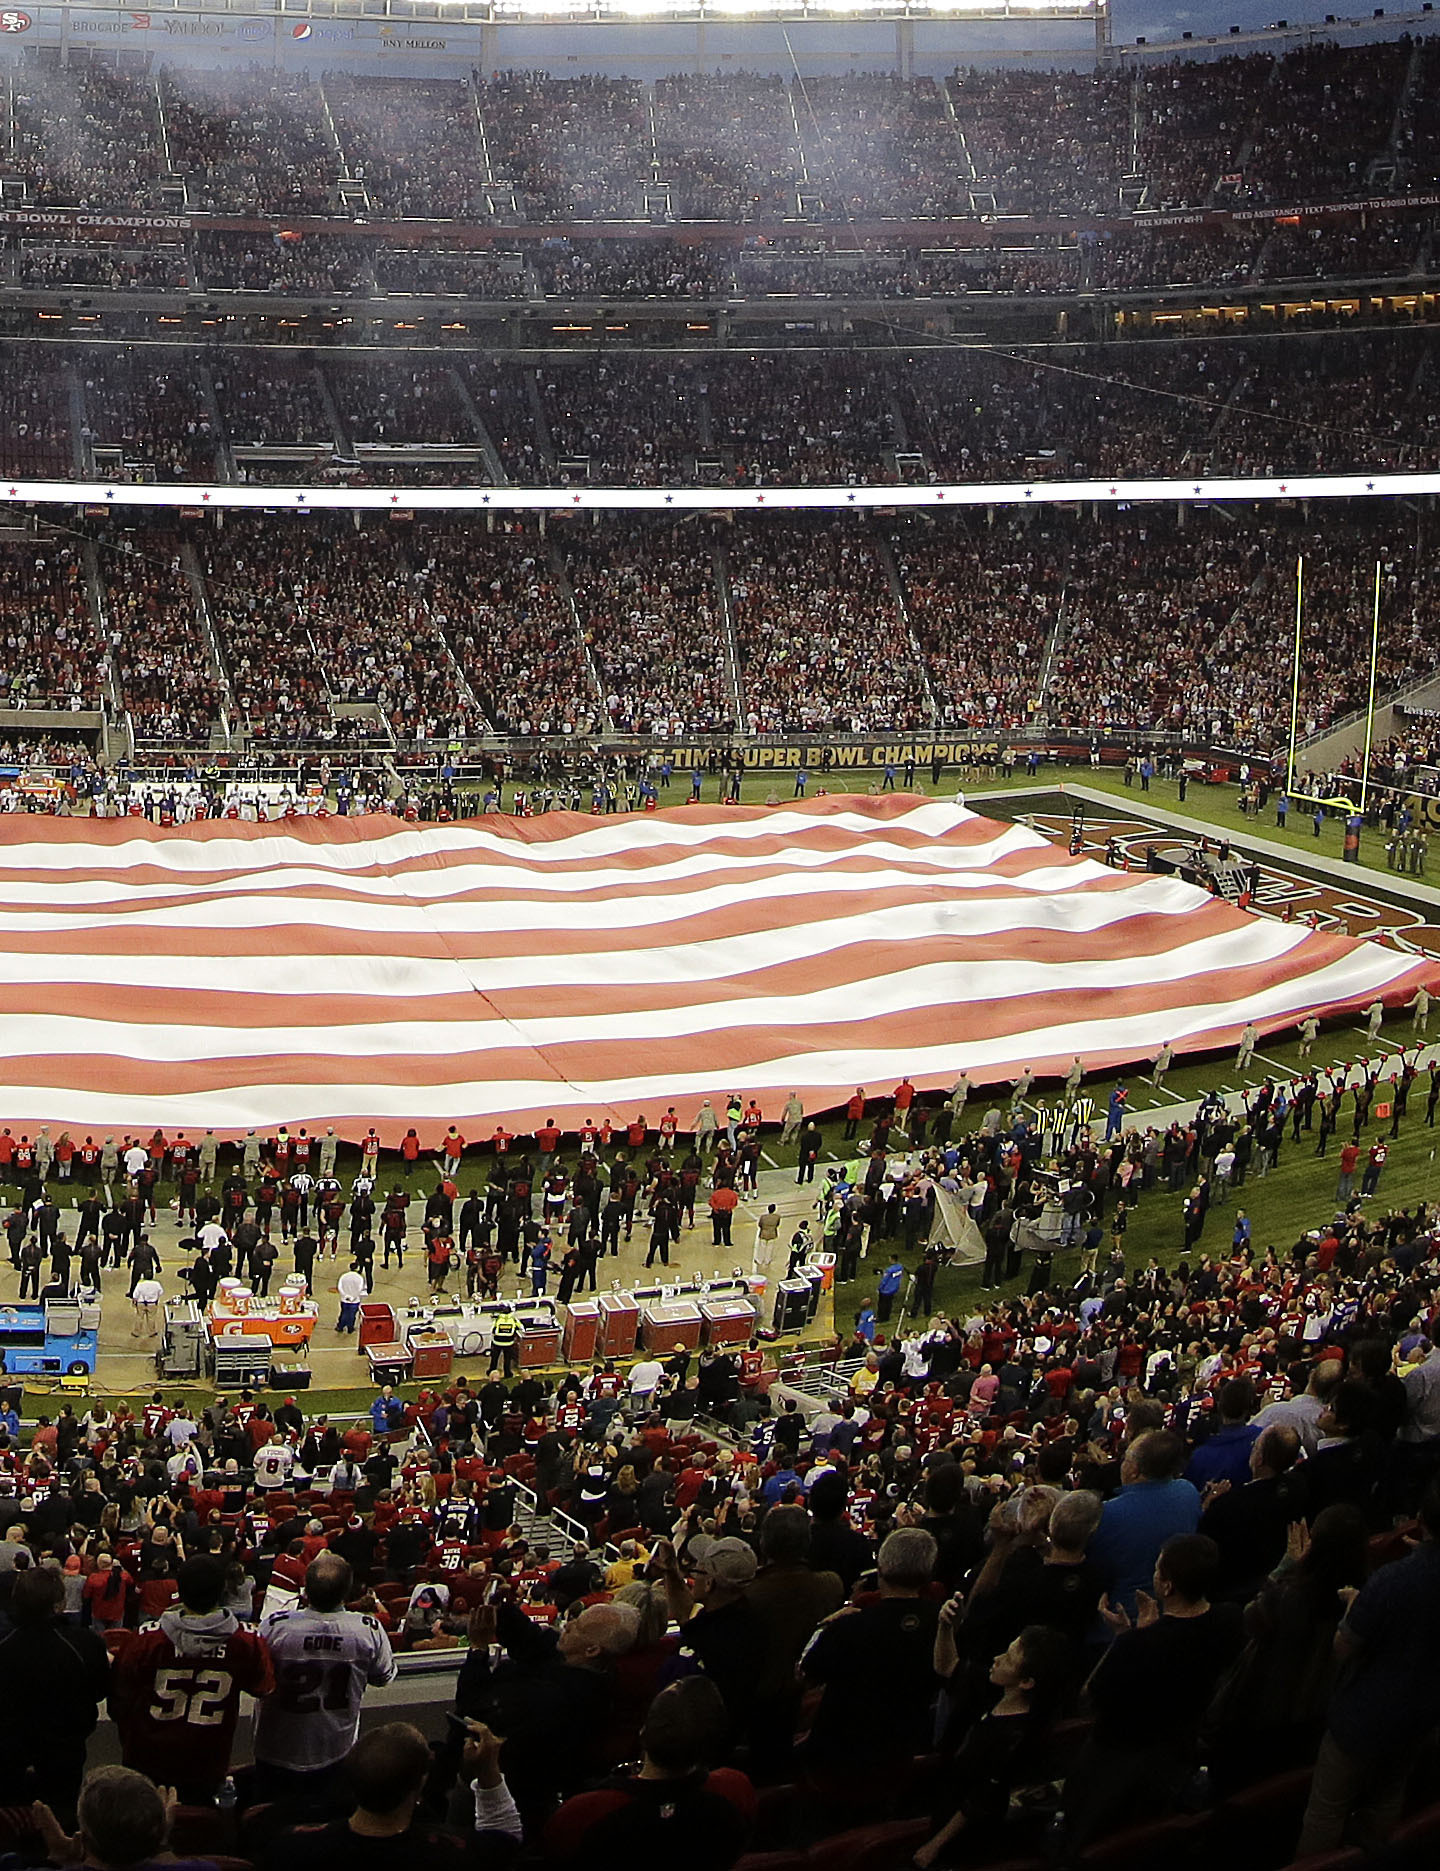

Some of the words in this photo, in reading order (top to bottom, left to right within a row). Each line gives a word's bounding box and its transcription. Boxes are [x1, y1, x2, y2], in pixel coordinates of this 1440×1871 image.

[72, 20, 128, 34] BROCADE
[164, 18, 224, 37] YAHOO!
[382, 39, 403, 49] BNY
[404, 40, 447, 51] MELLON
[1420, 195, 1440, 206] CALL
[16, 212, 72, 225] BOWL
[76, 214, 193, 229] CHAMPIONS
[223, 1321, 245, 1337] G
[149, 1415, 160, 1430] 7
[563, 1414, 579, 1427] 52
[265, 1458, 280, 1474] 8
[439, 1554, 461, 1570] 38
[303, 1634, 344, 1652] GORE
[149, 1668, 234, 1726] 52
